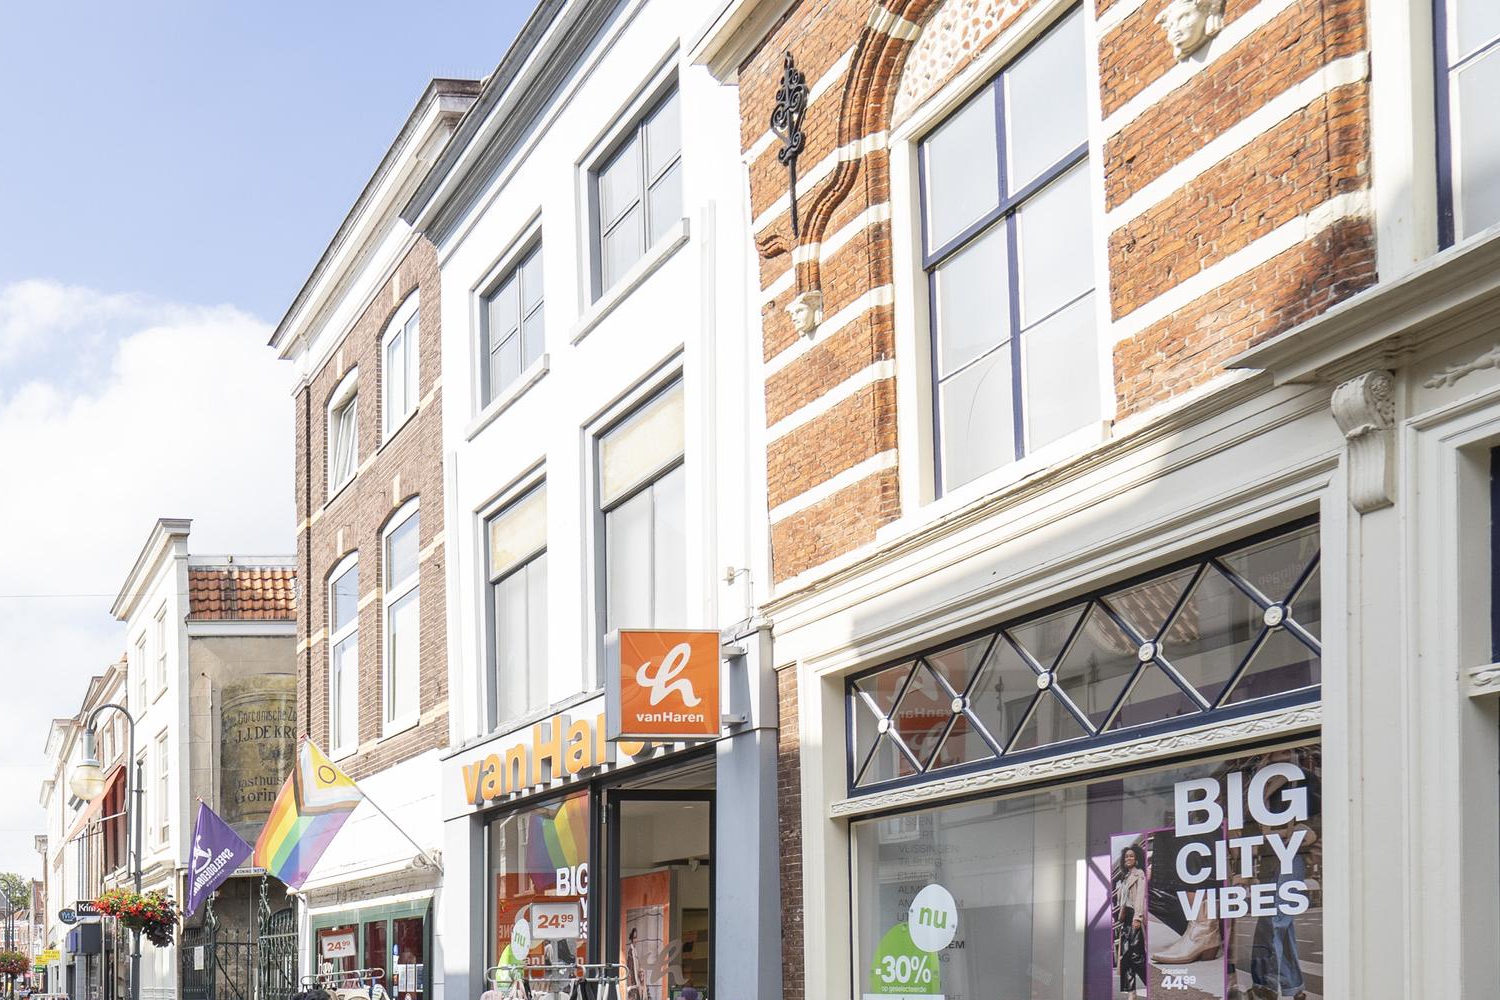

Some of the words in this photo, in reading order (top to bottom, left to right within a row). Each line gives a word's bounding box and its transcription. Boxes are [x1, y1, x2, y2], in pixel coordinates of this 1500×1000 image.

[636, 711, 704, 723] vanHaren
[462, 713, 607, 805] vanHar
[1174, 762, 1309, 838] BIG
[1175, 830, 1308, 884] CITY
[1176, 880, 1310, 921] VIBES
[537, 914, 574, 929] 24.99
[919, 907, 947, 929] nu
[327, 940, 351, 952] 24.99
[515, 931, 526, 947] nu
[875, 955, 932, 984] -30%
[1161, 975, 1197, 990] 44.99
